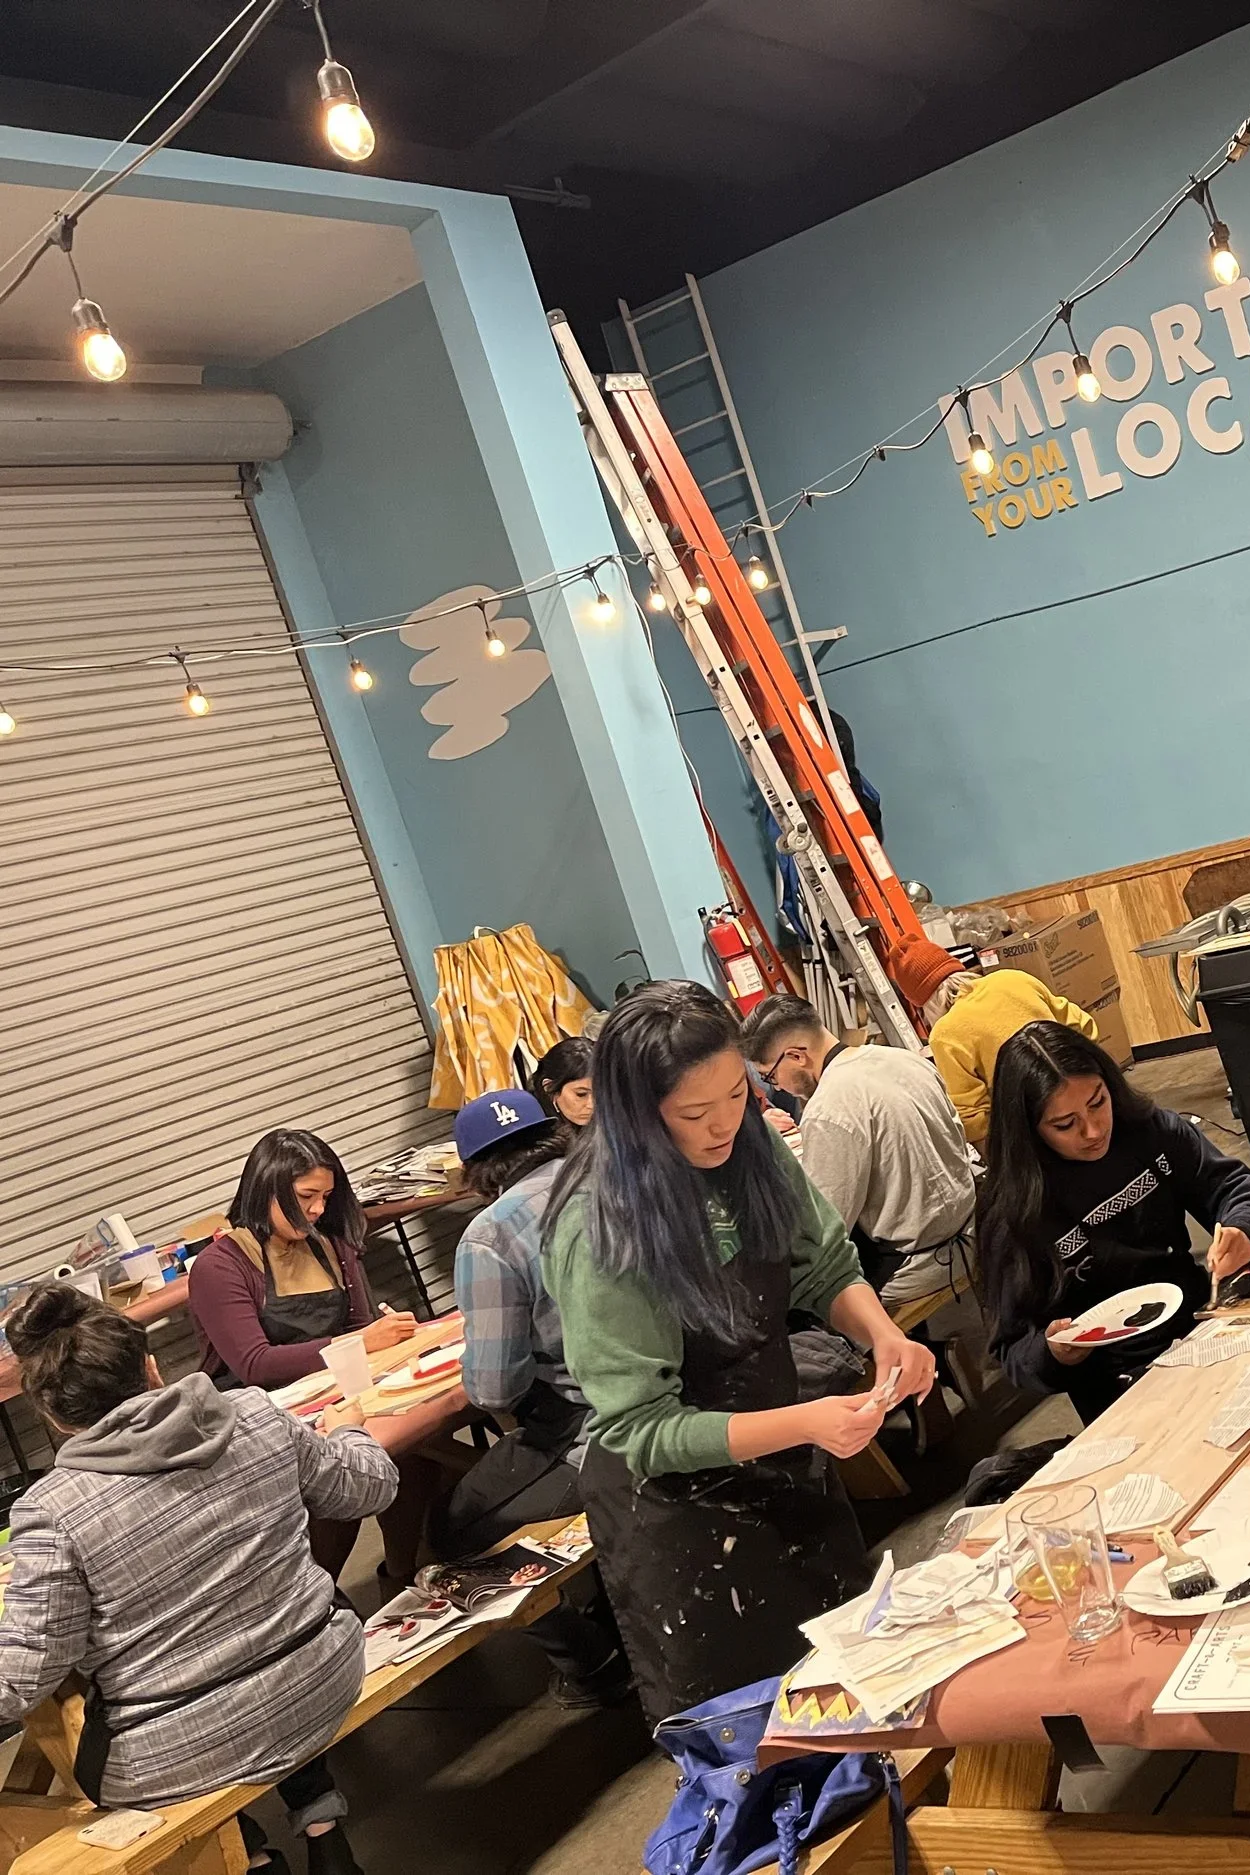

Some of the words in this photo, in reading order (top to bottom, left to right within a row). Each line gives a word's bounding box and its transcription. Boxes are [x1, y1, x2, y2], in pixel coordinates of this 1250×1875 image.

[960, 438, 1068, 504] FROM
[971, 476, 1080, 538] YOUR
[489, 1101, 520, 1127] LA
